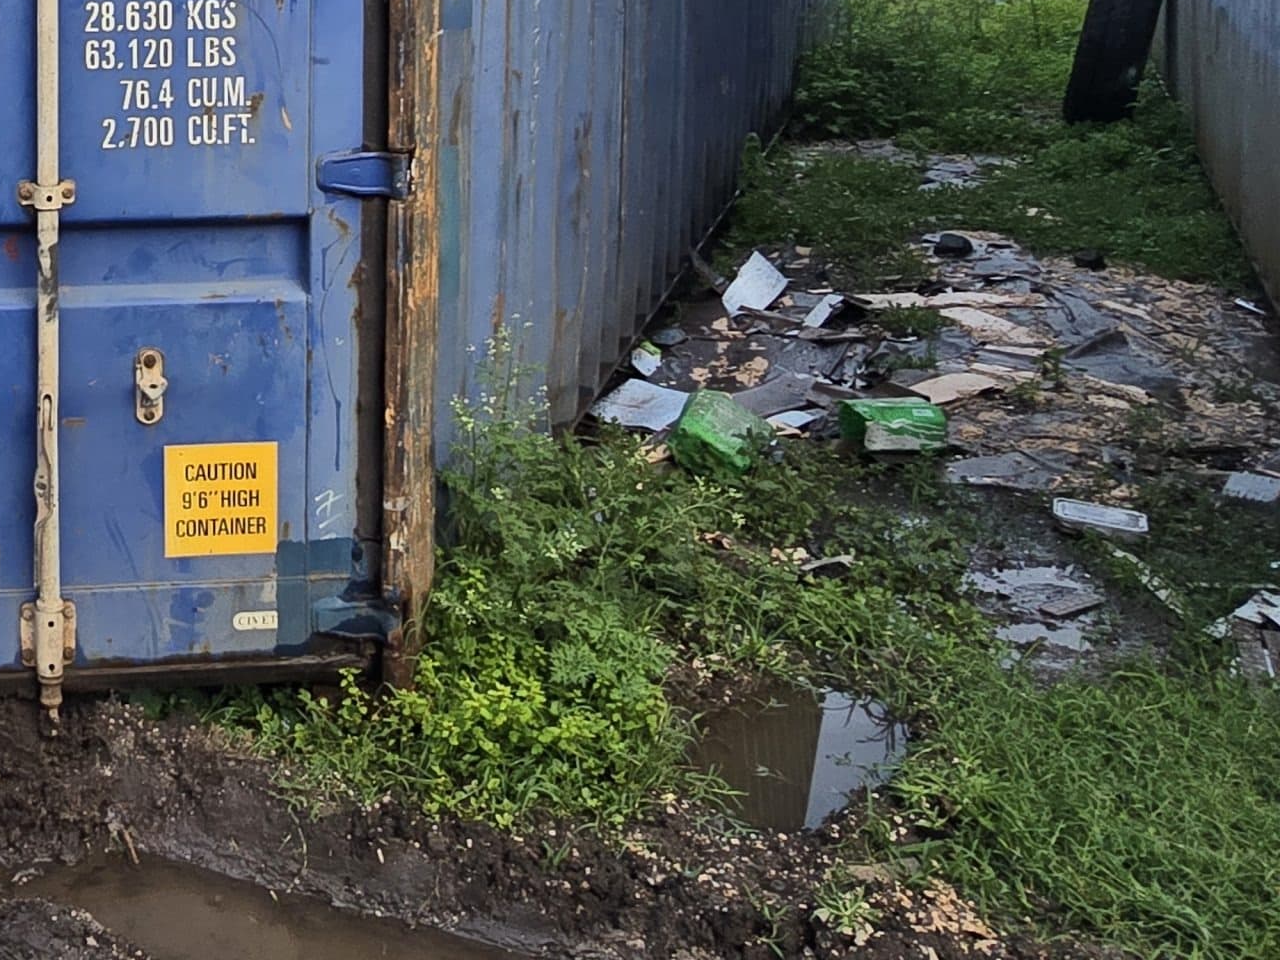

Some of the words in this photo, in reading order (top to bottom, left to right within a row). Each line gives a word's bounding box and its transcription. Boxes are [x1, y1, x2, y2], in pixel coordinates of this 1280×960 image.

[186, 36, 237, 68] LBS
[119, 77, 175, 111] 76.4
[187, 76, 253, 108] CU.M.
[187, 113, 257, 146] CU.FT.
[184, 461, 258, 482] CAUTION
[220, 489, 260, 508] HIGH
[175, 516, 267, 538] CONTAINER
